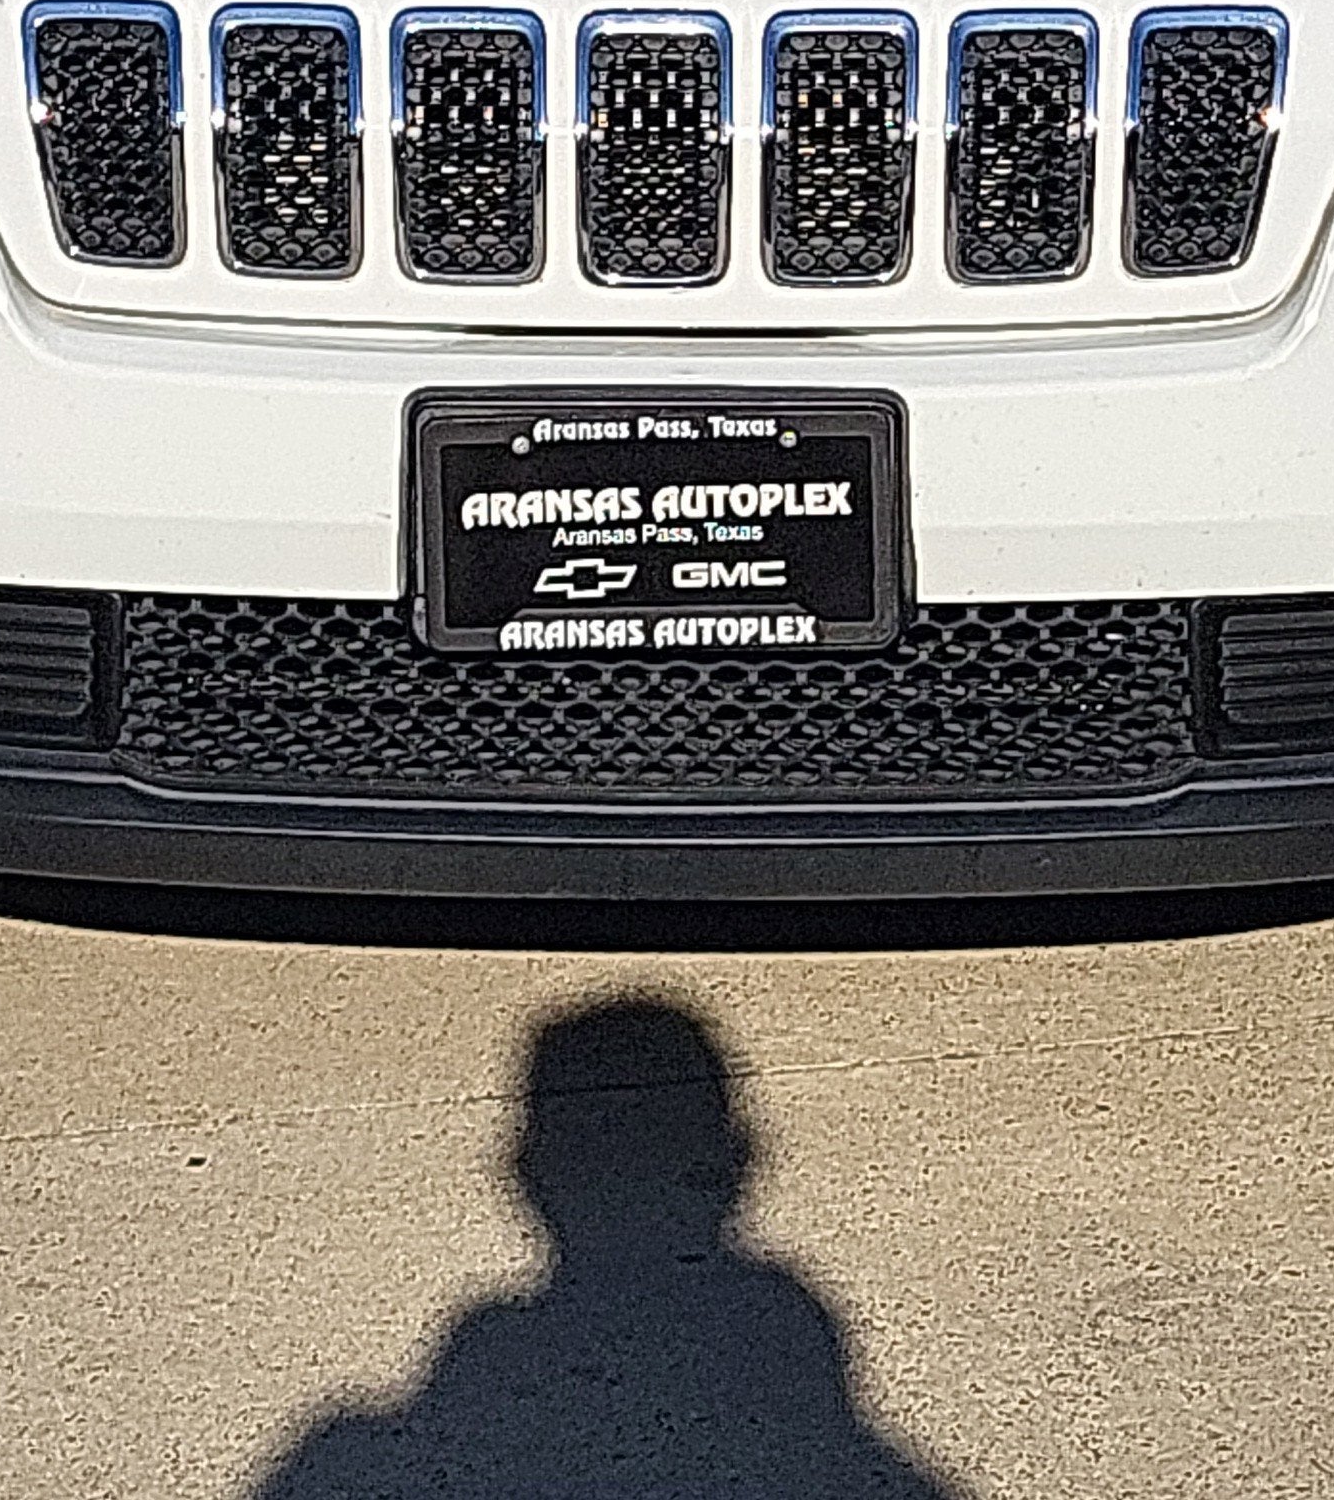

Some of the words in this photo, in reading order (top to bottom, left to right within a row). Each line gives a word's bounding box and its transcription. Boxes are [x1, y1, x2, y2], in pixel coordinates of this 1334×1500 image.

[533, 419, 629, 442] Aransas
[638, 417, 699, 440] Pass,
[708, 416, 777, 437] Texas
[461, 487, 643, 530] ARANSAS
[652, 482, 852, 523] AUTOPLEX
[553, 527, 637, 548] Aransas
[642, 524, 698, 545] Pass,
[704, 522, 763, 541] Texas
[673, 561, 786, 588] GMC
[500, 620, 645, 651] ARANSAS
[654, 616, 816, 648] AUTOPLEX
